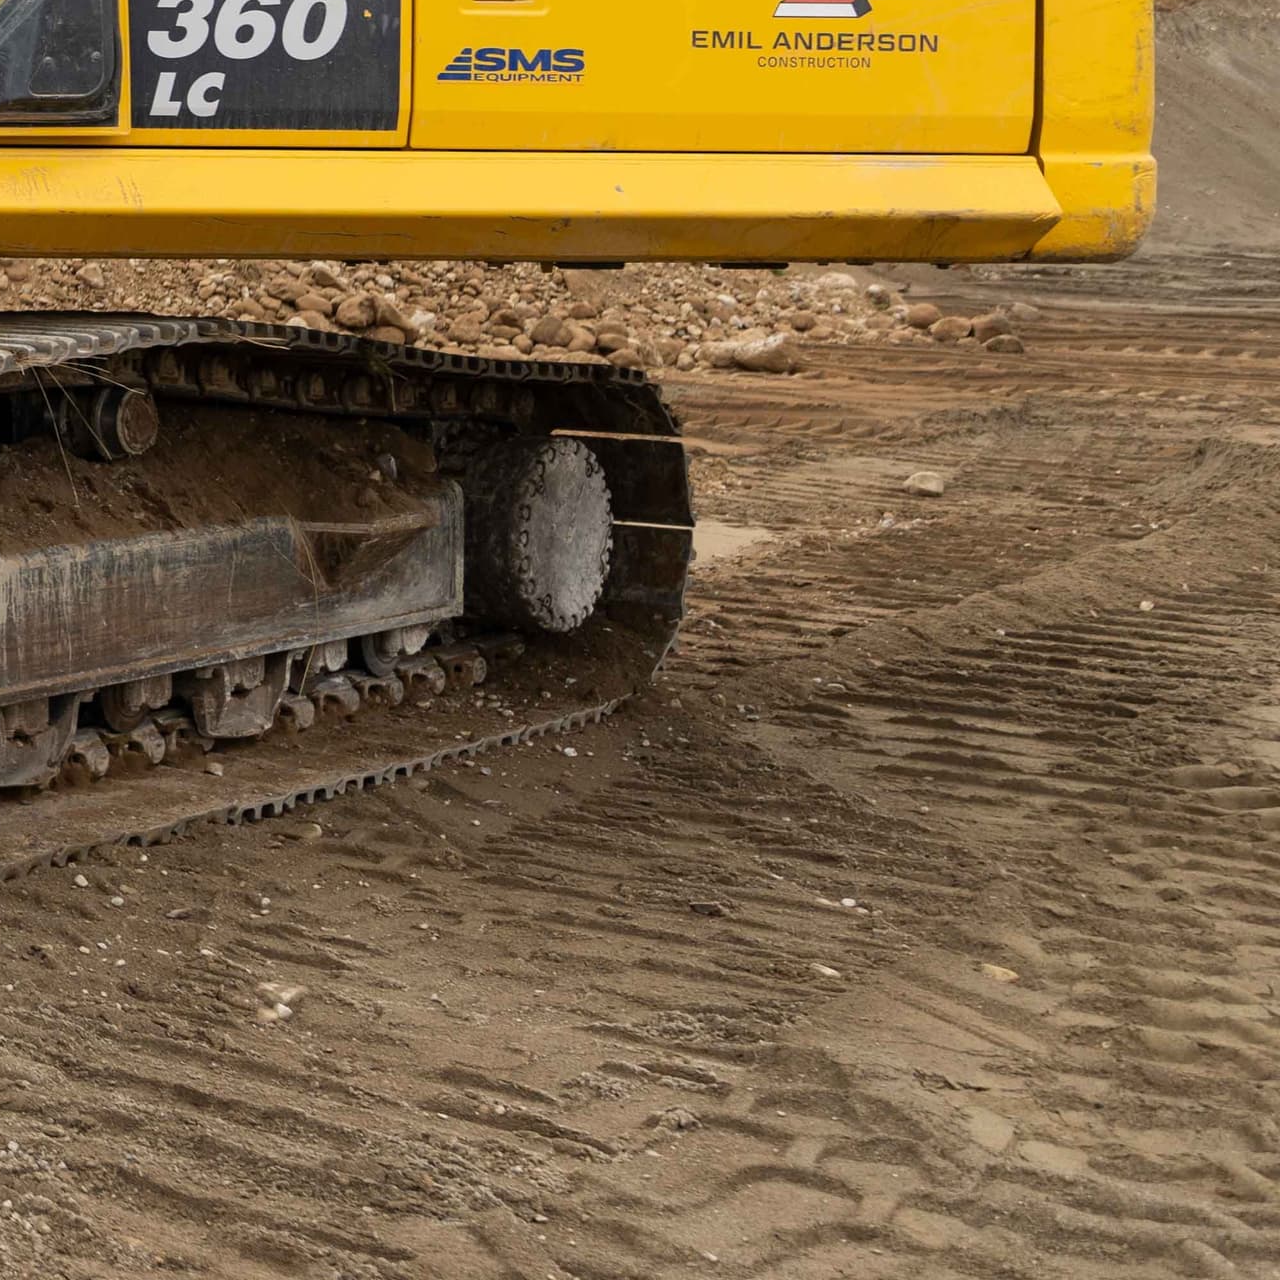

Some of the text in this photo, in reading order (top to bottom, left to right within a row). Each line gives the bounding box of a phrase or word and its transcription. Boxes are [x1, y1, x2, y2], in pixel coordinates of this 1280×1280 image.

[691, 30, 939, 52] EMIL ANDERSON
[473, 47, 585, 72] SMS
[757, 56, 871, 68] CONSTRUCTION
[474, 73, 585, 82] EQUIPMENT
[149, 72, 226, 117] LC
